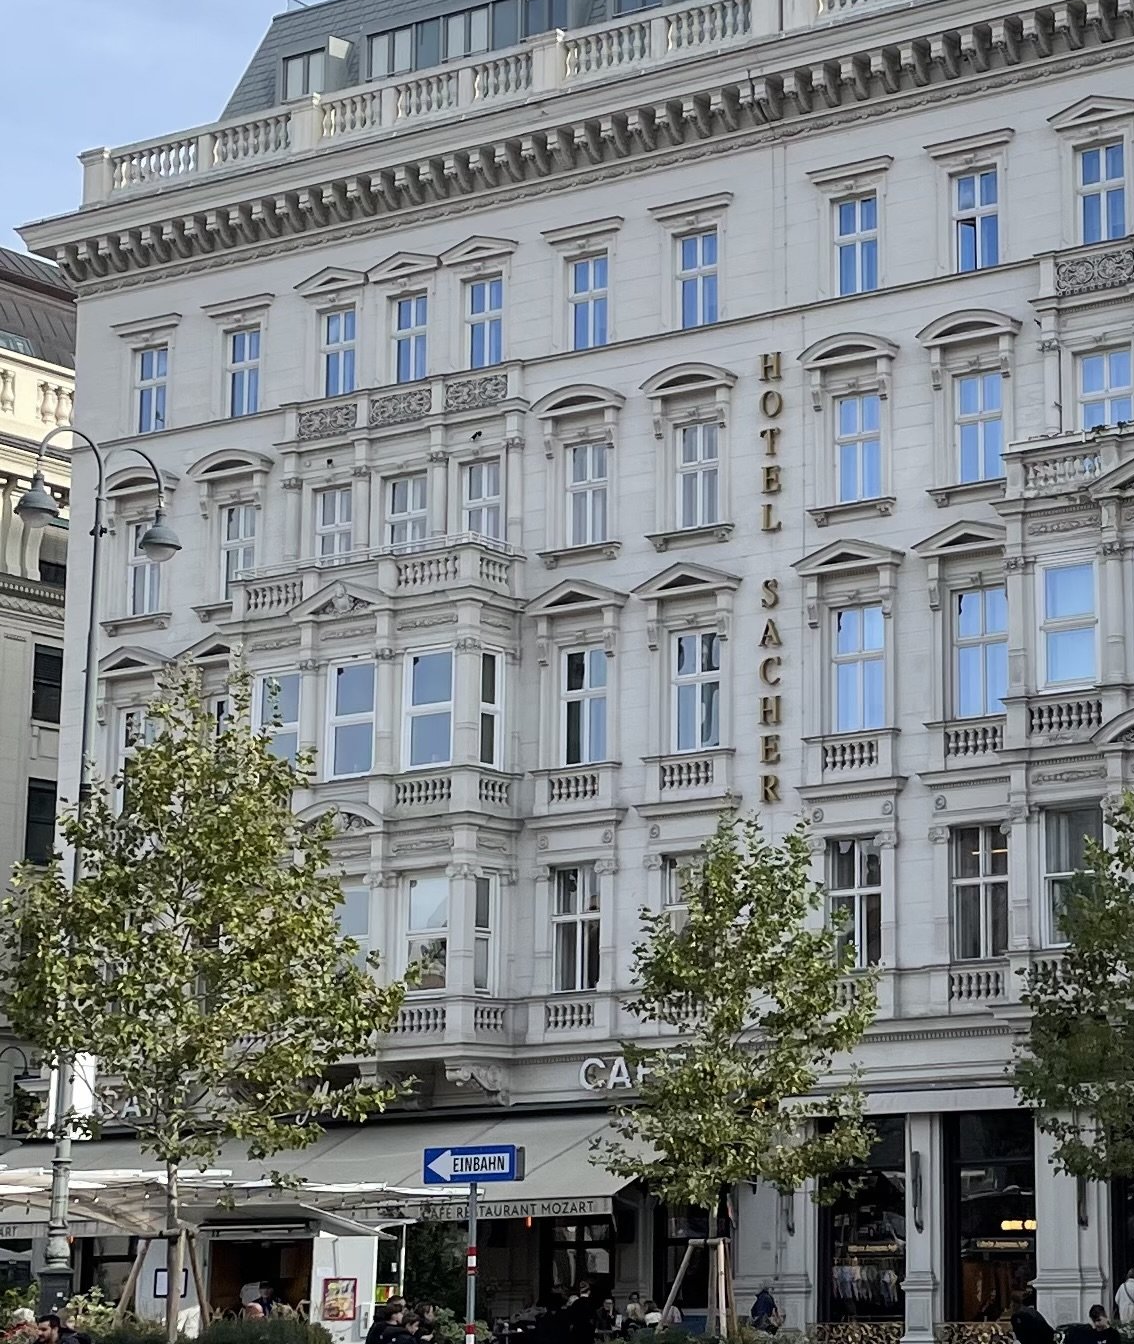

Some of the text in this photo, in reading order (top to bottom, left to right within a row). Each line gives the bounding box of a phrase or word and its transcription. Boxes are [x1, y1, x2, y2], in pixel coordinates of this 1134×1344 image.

[758, 351, 783, 803] HOTEL SACHER
[452, 1155, 506, 1173] EINBAHN
[456, 1203, 538, 1219] RETAURANT
[541, 1200, 594, 1216] MOZART
